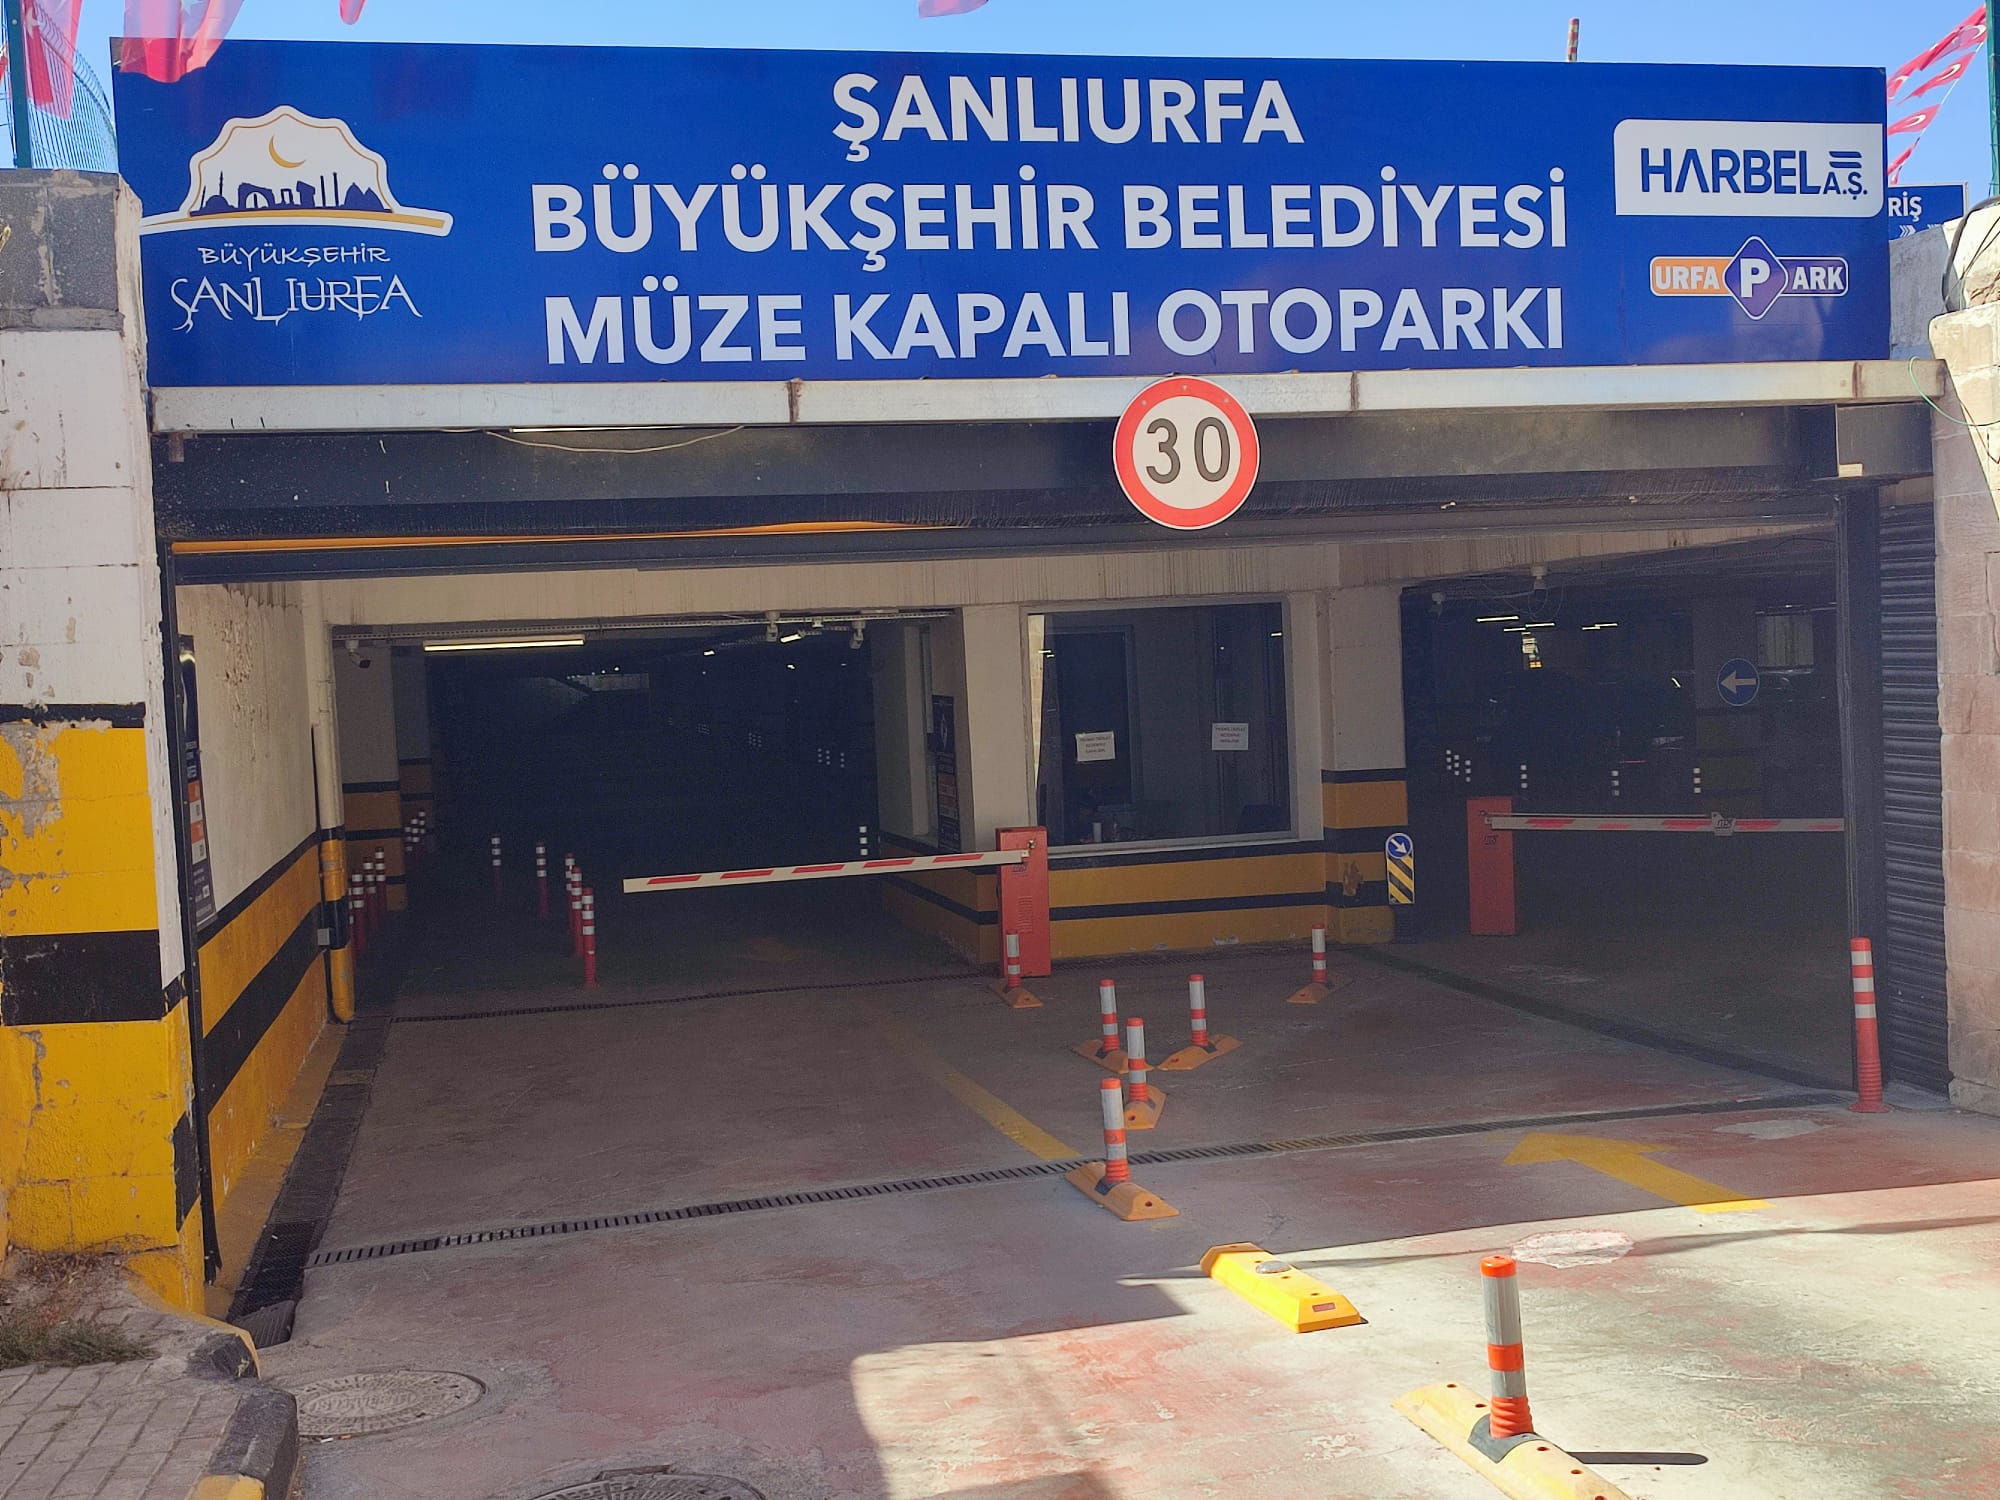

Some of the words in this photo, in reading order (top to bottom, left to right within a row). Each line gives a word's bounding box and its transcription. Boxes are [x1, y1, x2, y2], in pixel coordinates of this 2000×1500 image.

[832, 72, 1304, 162] ŞANLIURFA
[1640, 148, 1822, 195] HARBEL
[531, 163, 1098, 272] BÜYÜKŞEHİR
[1123, 165, 1567, 249] BELEDİYESİ
[198, 242, 391, 273] BÜYÜKŞEHİR
[170, 274, 423, 334] ŞANLIURFA
[544, 275, 806, 364] MÜZE
[834, 292, 1130, 361] KAPALI
[1157, 287, 1562, 355] OTOPARKI
[1146, 416, 1231, 484] 30
